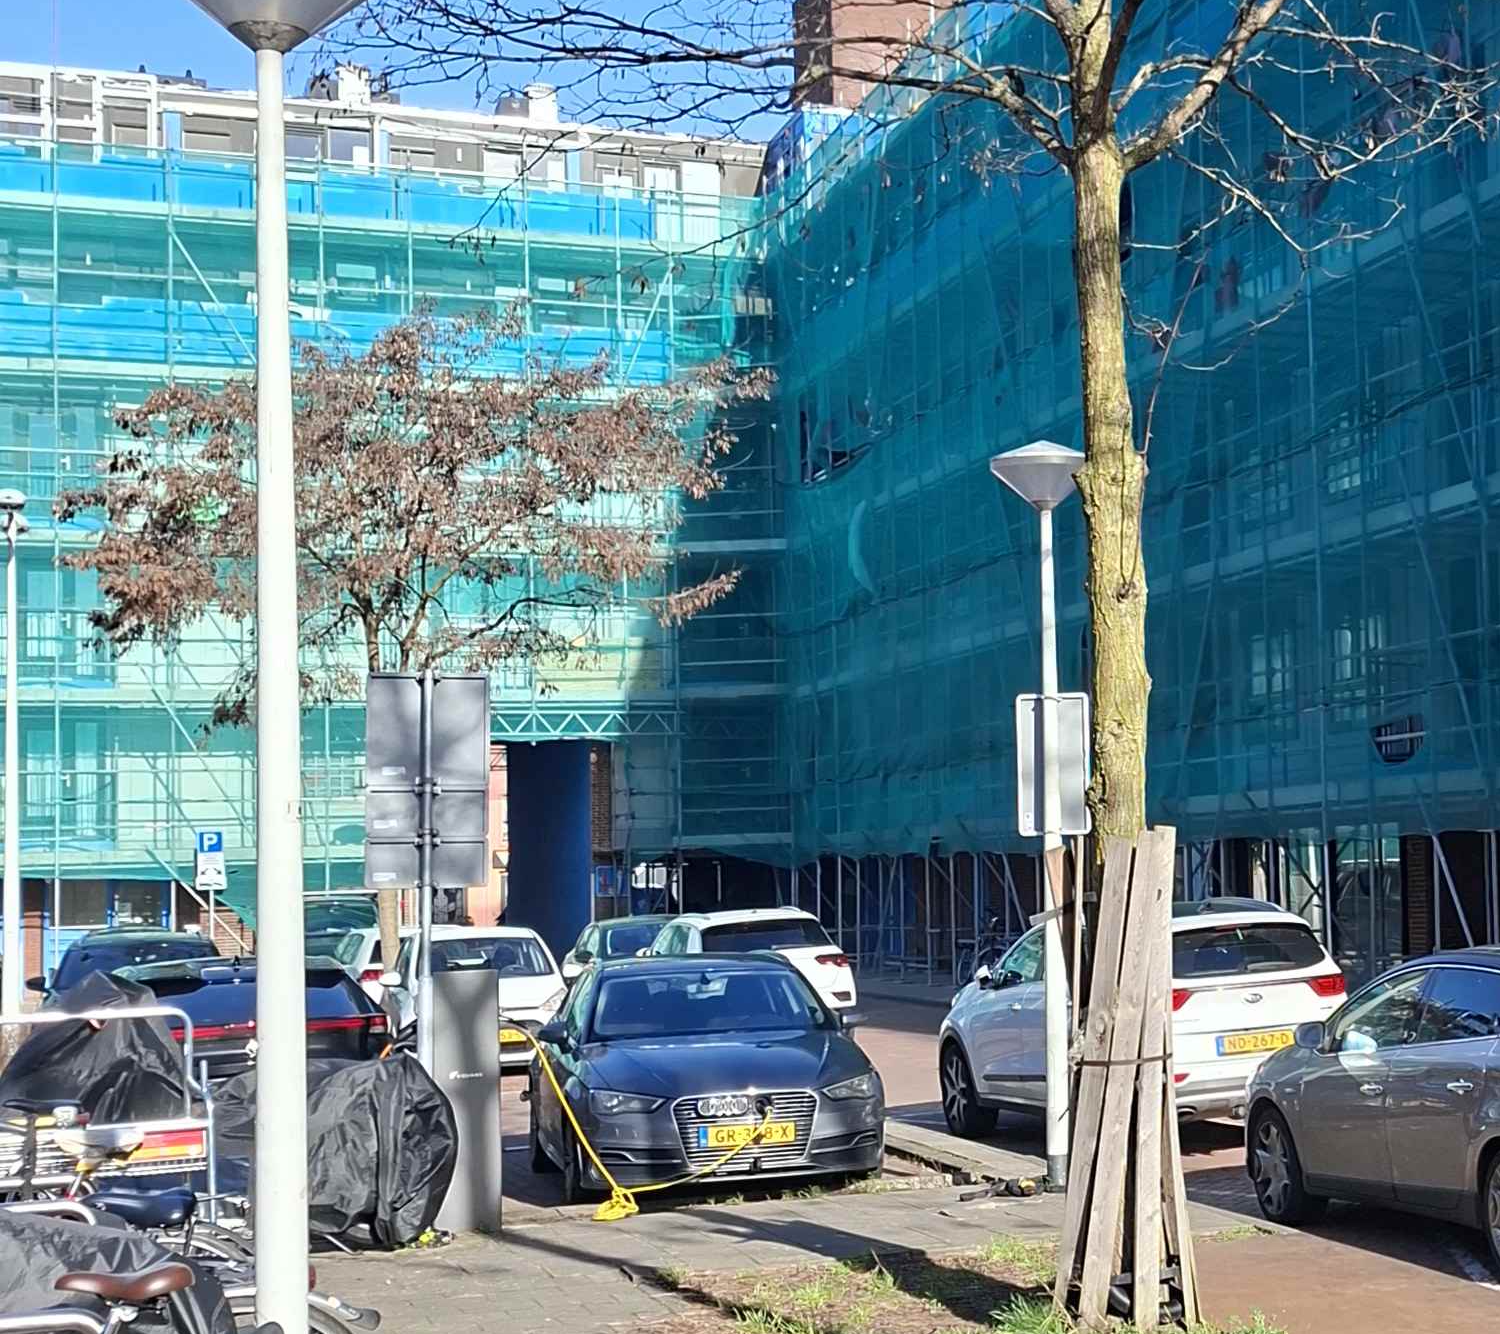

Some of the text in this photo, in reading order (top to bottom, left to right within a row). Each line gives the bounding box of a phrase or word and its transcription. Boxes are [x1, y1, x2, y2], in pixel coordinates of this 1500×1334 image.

[202, 833, 218, 852] P
[1227, 1033, 1289, 1050] ND-267-D
[714, 1125, 790, 1144] GR-38-X
